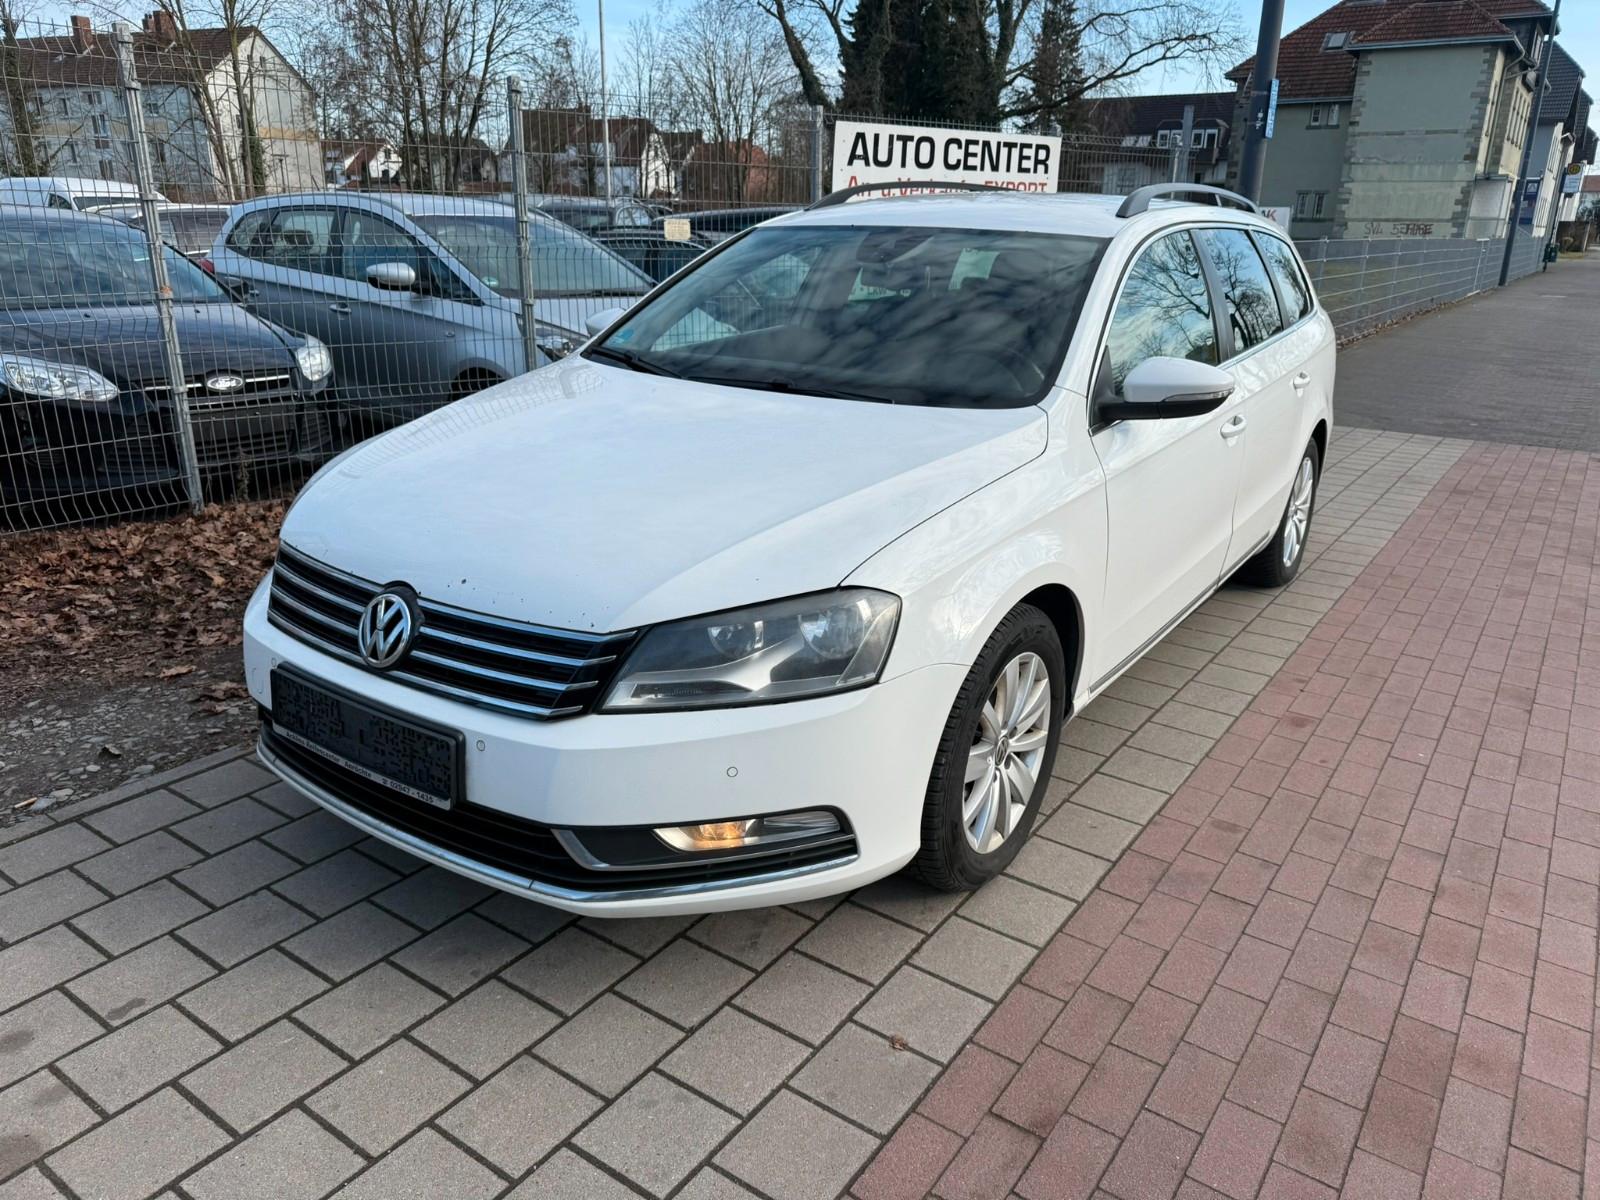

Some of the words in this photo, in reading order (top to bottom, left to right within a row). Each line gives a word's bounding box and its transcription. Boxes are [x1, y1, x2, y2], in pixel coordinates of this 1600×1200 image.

[847, 132, 935, 169] AUTO
[943, 138, 1050, 174] CENTER
[359, 594, 410, 666] VW
